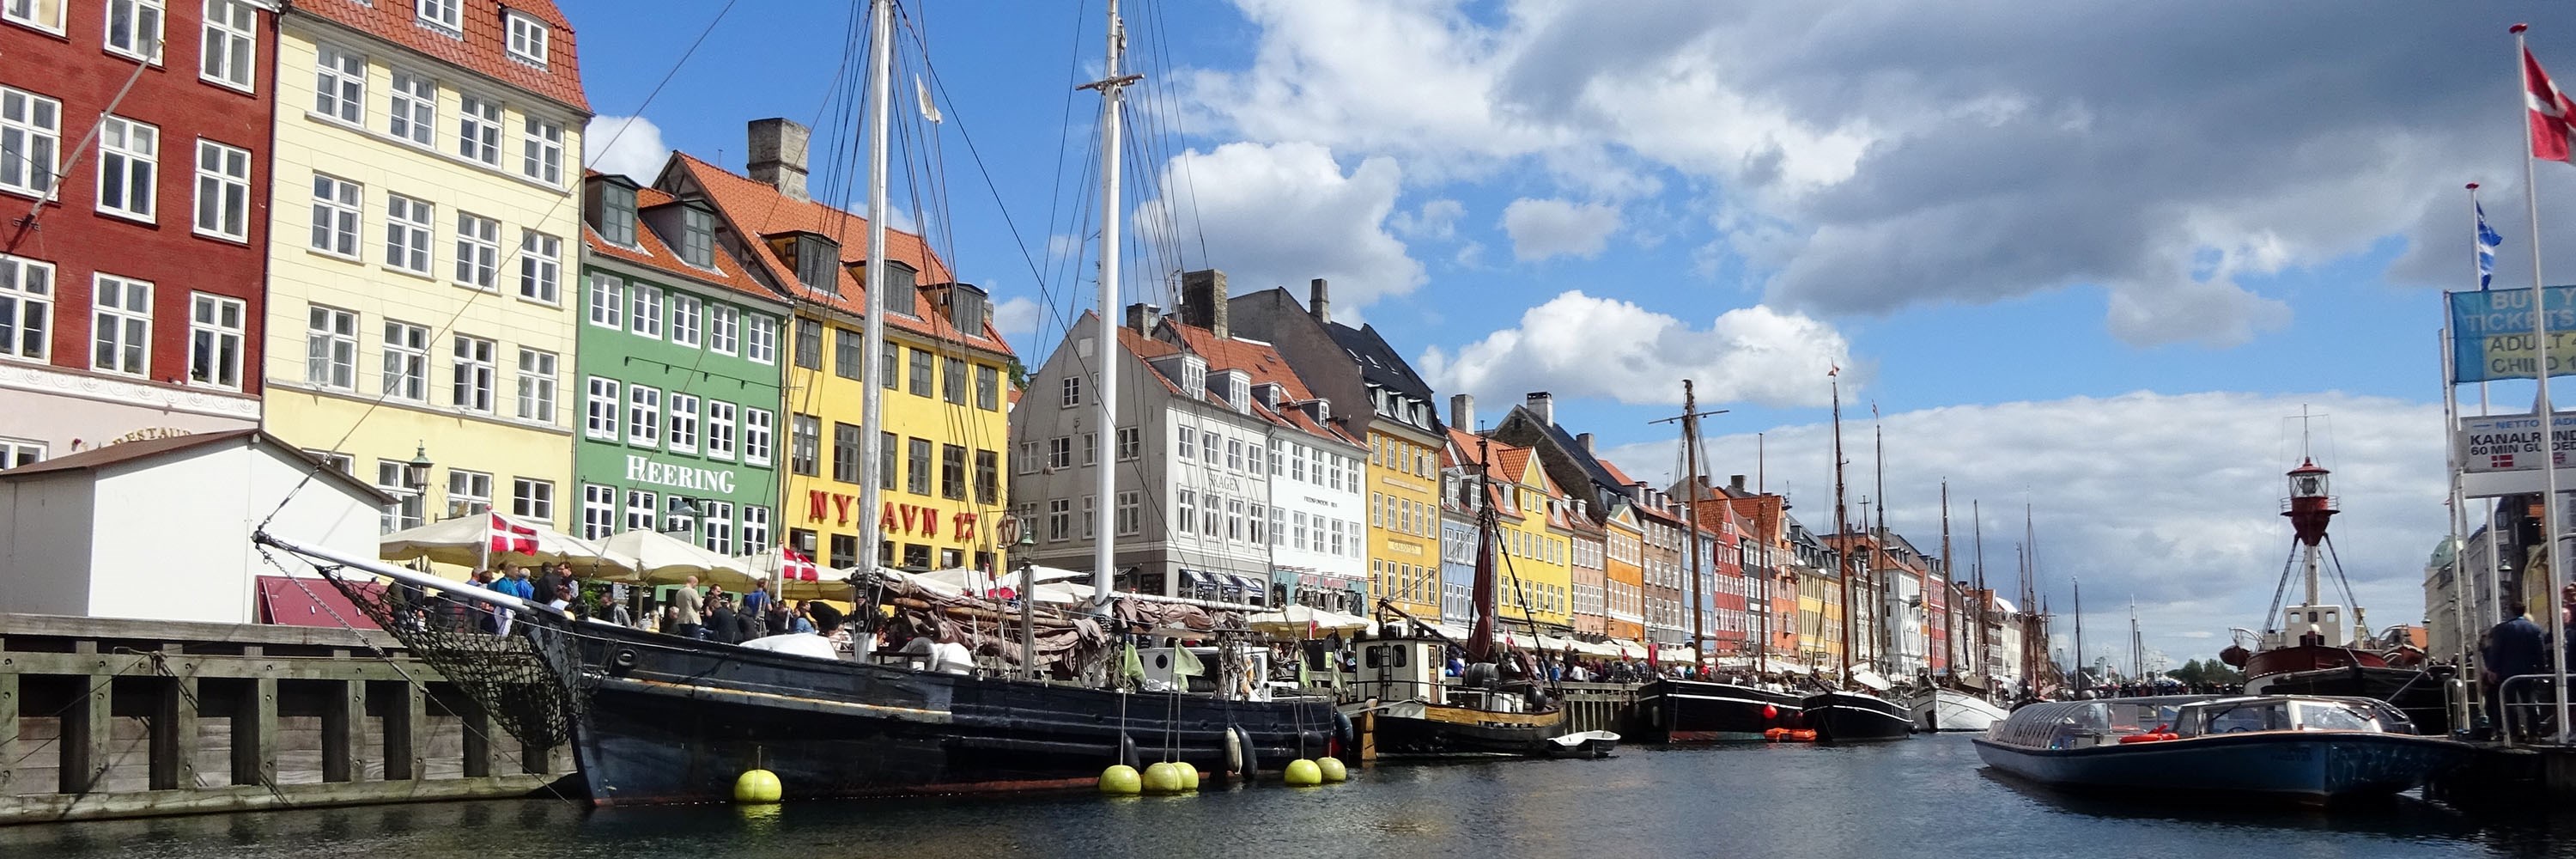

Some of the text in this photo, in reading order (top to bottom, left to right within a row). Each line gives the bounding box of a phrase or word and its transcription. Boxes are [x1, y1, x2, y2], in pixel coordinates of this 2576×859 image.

[2491, 290, 2544, 310] BU
[2470, 430, 2576, 445] KANALRND
[2470, 446, 2488, 455] 60
[2491, 443, 2519, 454] MIN
[626, 454, 736, 494] HEERING
[809, 490, 978, 539] NYAVN 17
[997, 519, 1017, 544] 17
